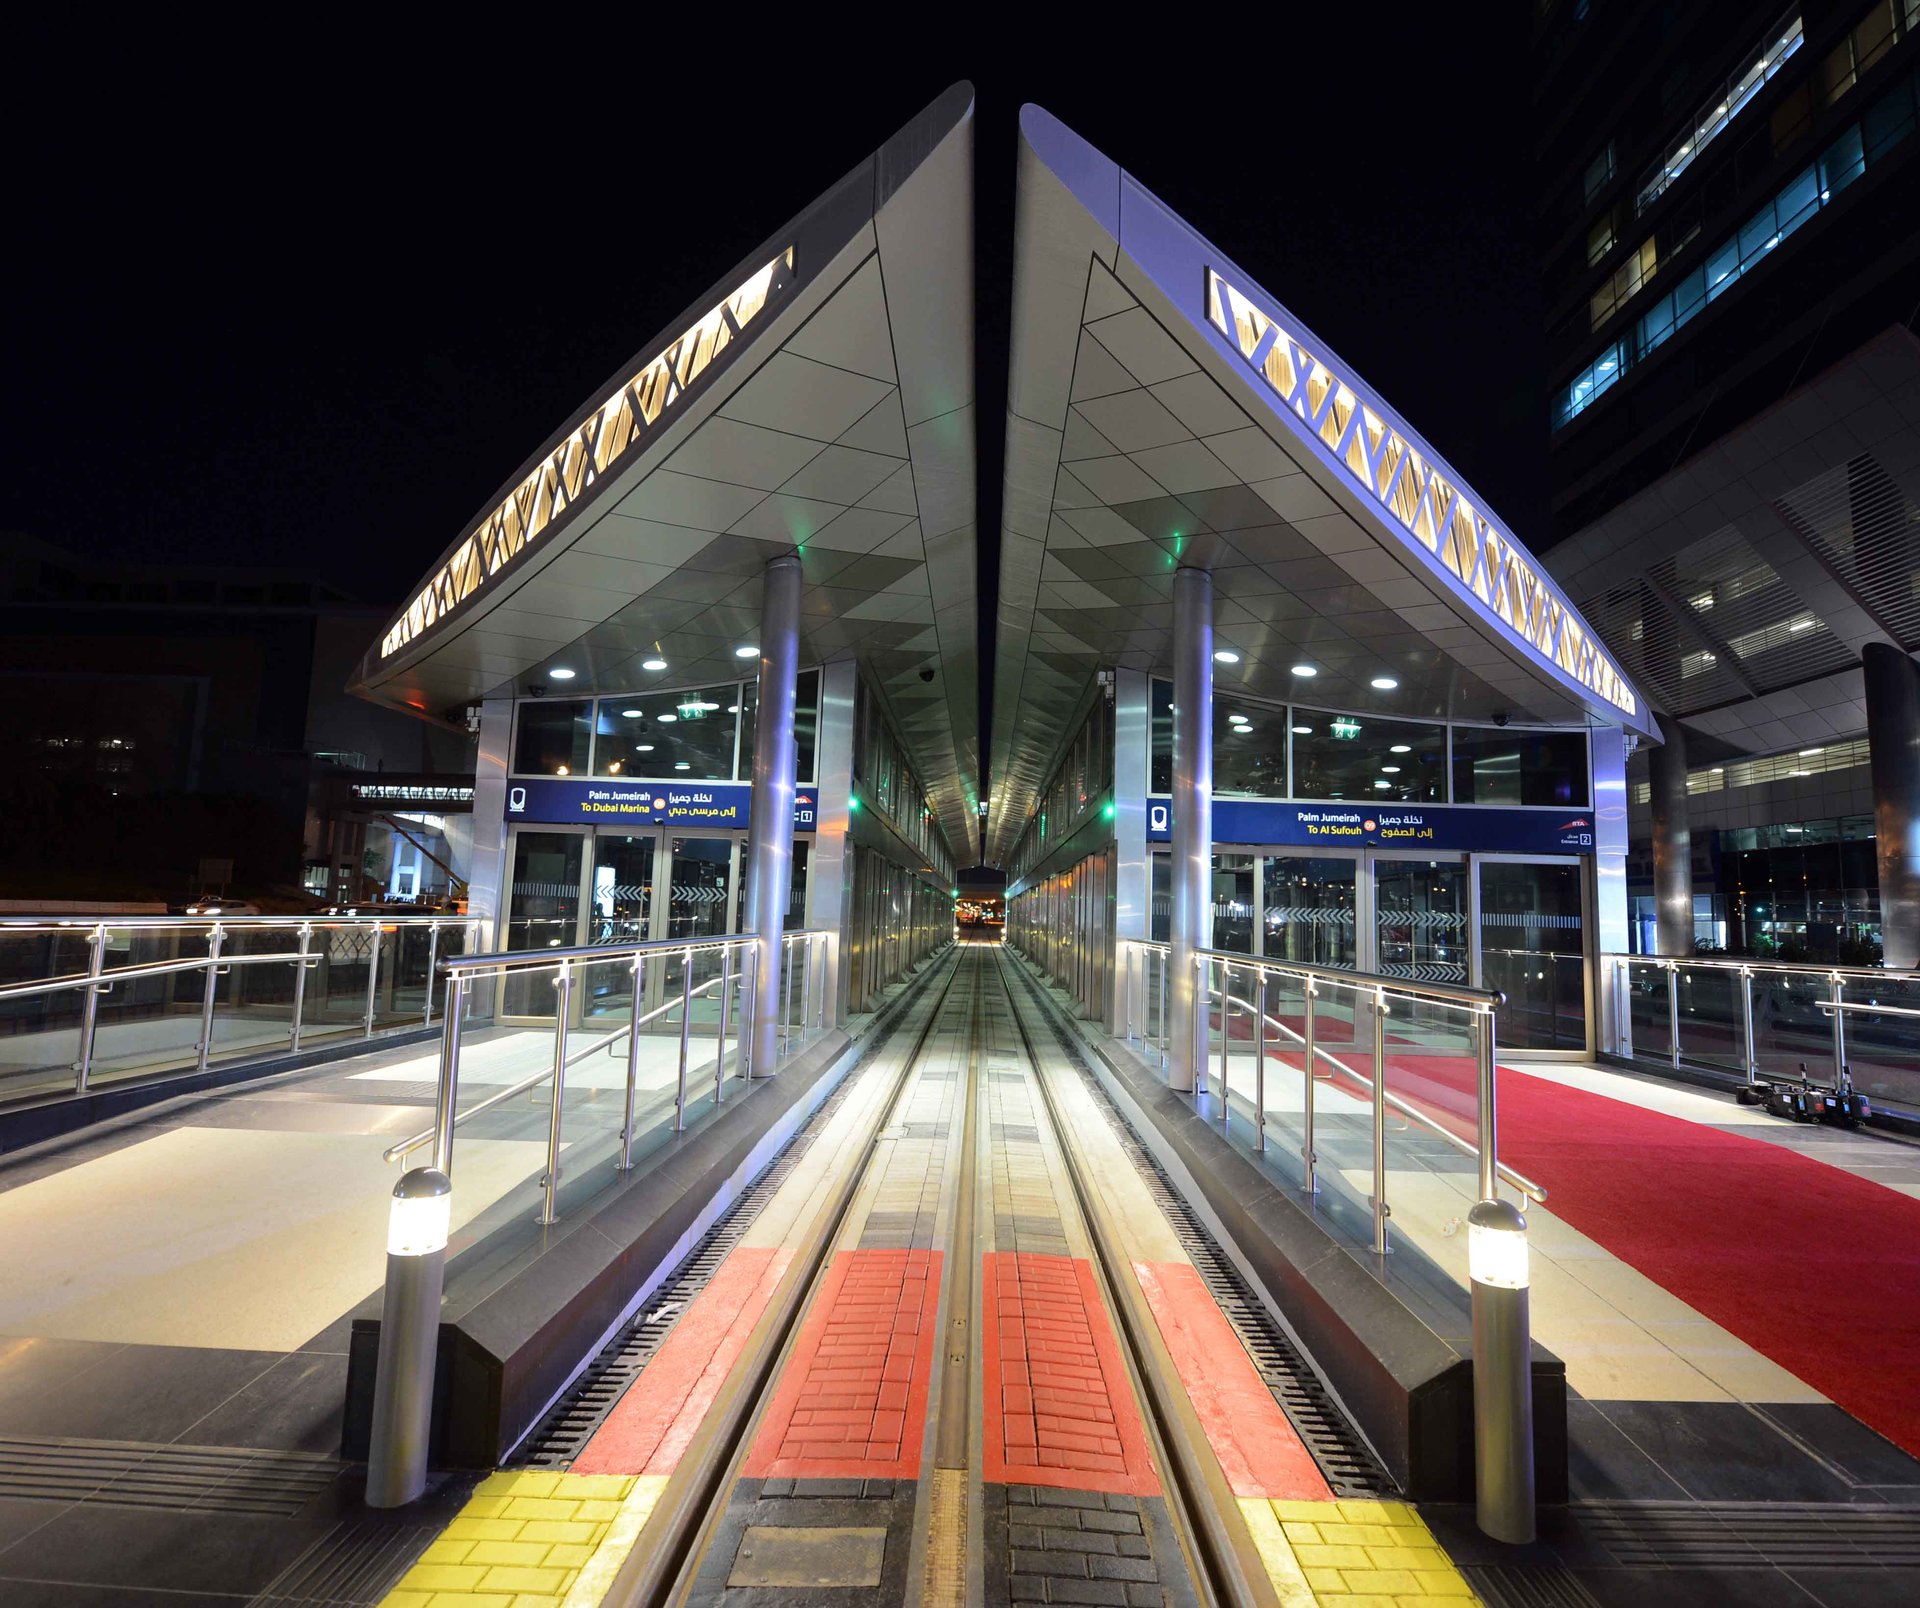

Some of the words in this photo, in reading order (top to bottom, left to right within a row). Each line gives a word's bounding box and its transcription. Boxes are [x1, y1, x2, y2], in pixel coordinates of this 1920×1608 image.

[589, 791, 610, 800] Palm
[611, 791, 650, 801] Jumeirah
[669, 792, 691, 804] جميرا
[692, 793, 712, 803] نخلة
[581, 802, 592, 812] To
[593, 803, 619, 812] Dubai
[620, 804, 650, 814] Marina
[668, 807, 688, 817] دبي
[689, 808, 719, 817] مرسى
[720, 806, 736, 818] إلى
[1298, 812, 1319, 822] Palm
[1320, 813, 1361, 823] Jumeirah
[1379, 814, 1402, 826] جميرا
[1403, 815, 1423, 825] نخلة
[1307, 824, 1319, 834] To
[1320, 825, 1329, 834] Al
[1331, 825, 1362, 835] Sufouh
[1381, 827, 1415, 838] الصفوح
[1417, 828, 1433, 839] إلى
